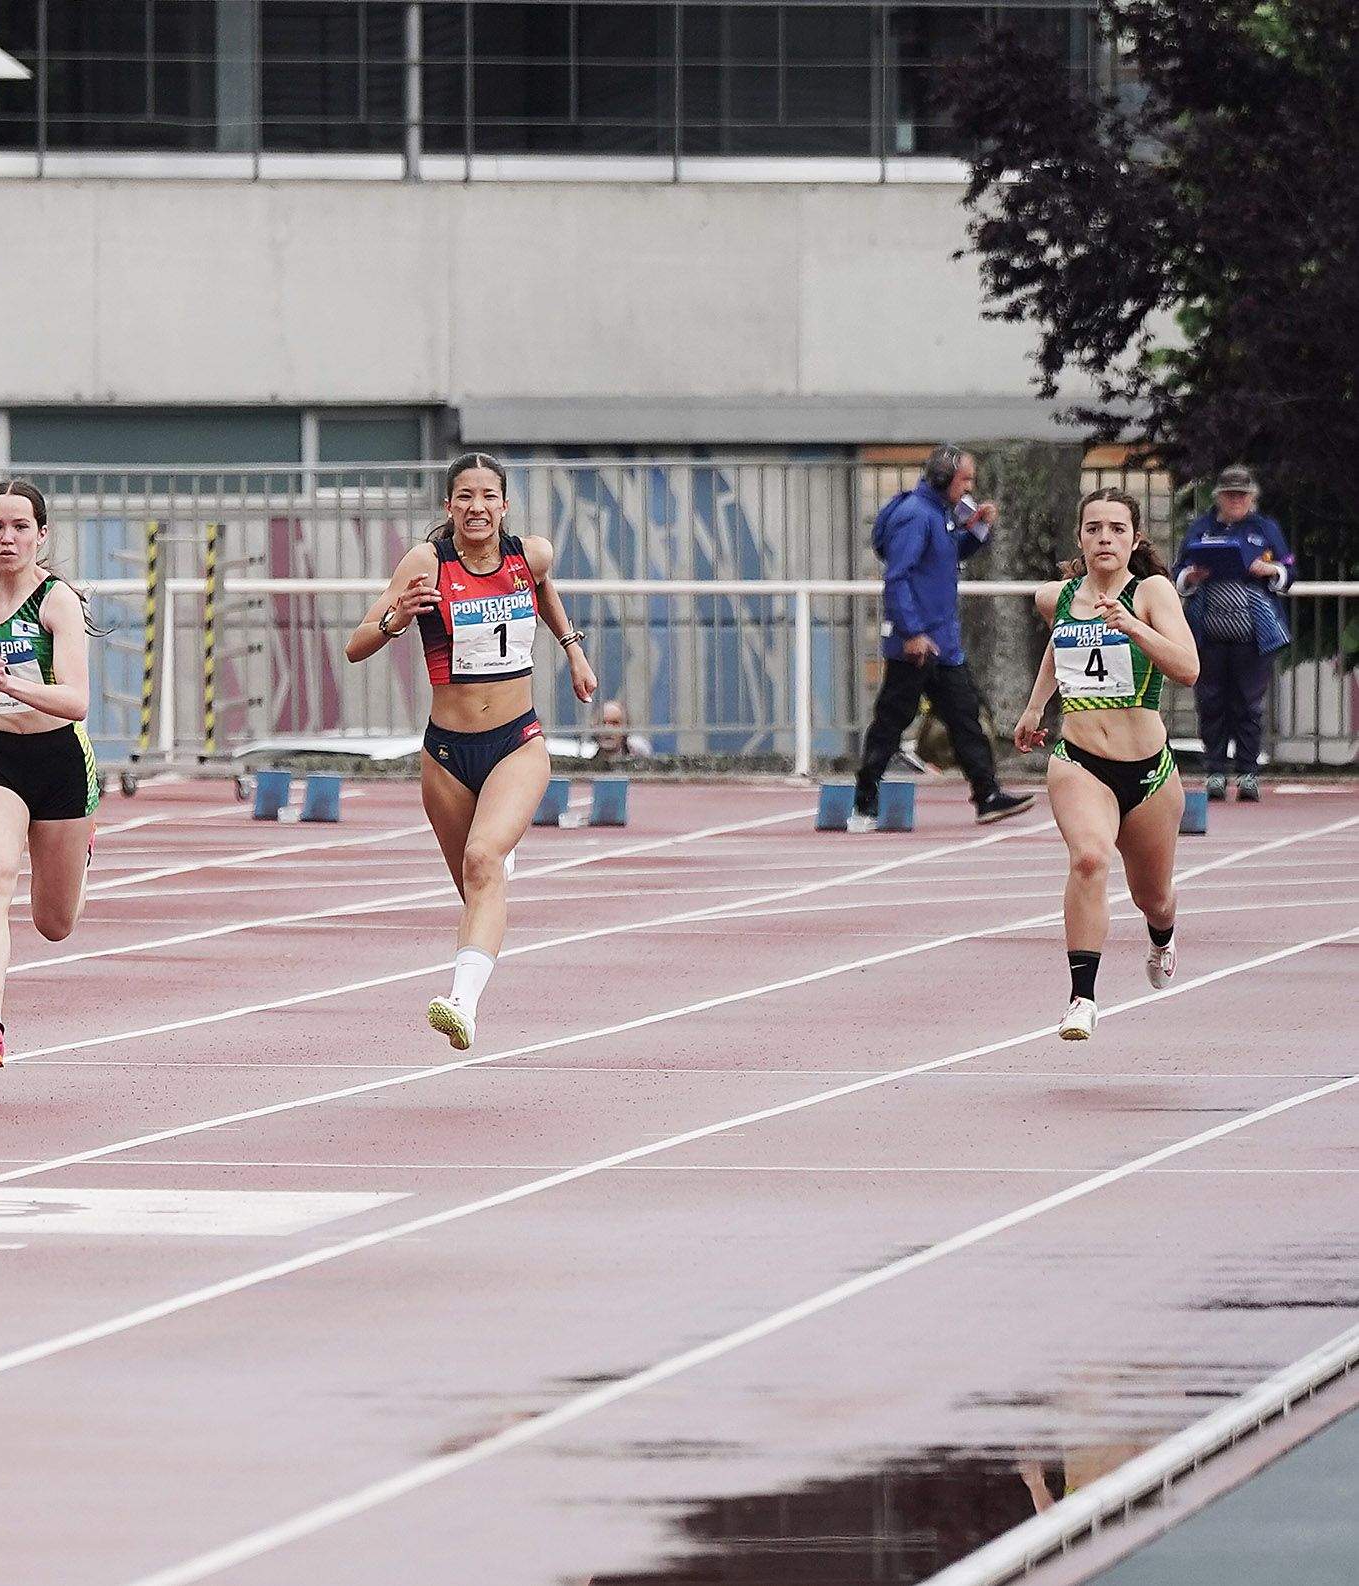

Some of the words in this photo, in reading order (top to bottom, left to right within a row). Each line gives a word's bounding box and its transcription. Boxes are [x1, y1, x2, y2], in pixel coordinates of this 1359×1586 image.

[453, 592, 533, 616] PONTEVEDRA
[482, 610, 512, 623] 2025
[493, 623, 507, 657] 1
[1055, 624, 1123, 638] PONTEVED
[1076, 636, 1103, 647] 2025
[1084, 648, 1108, 682] 4
